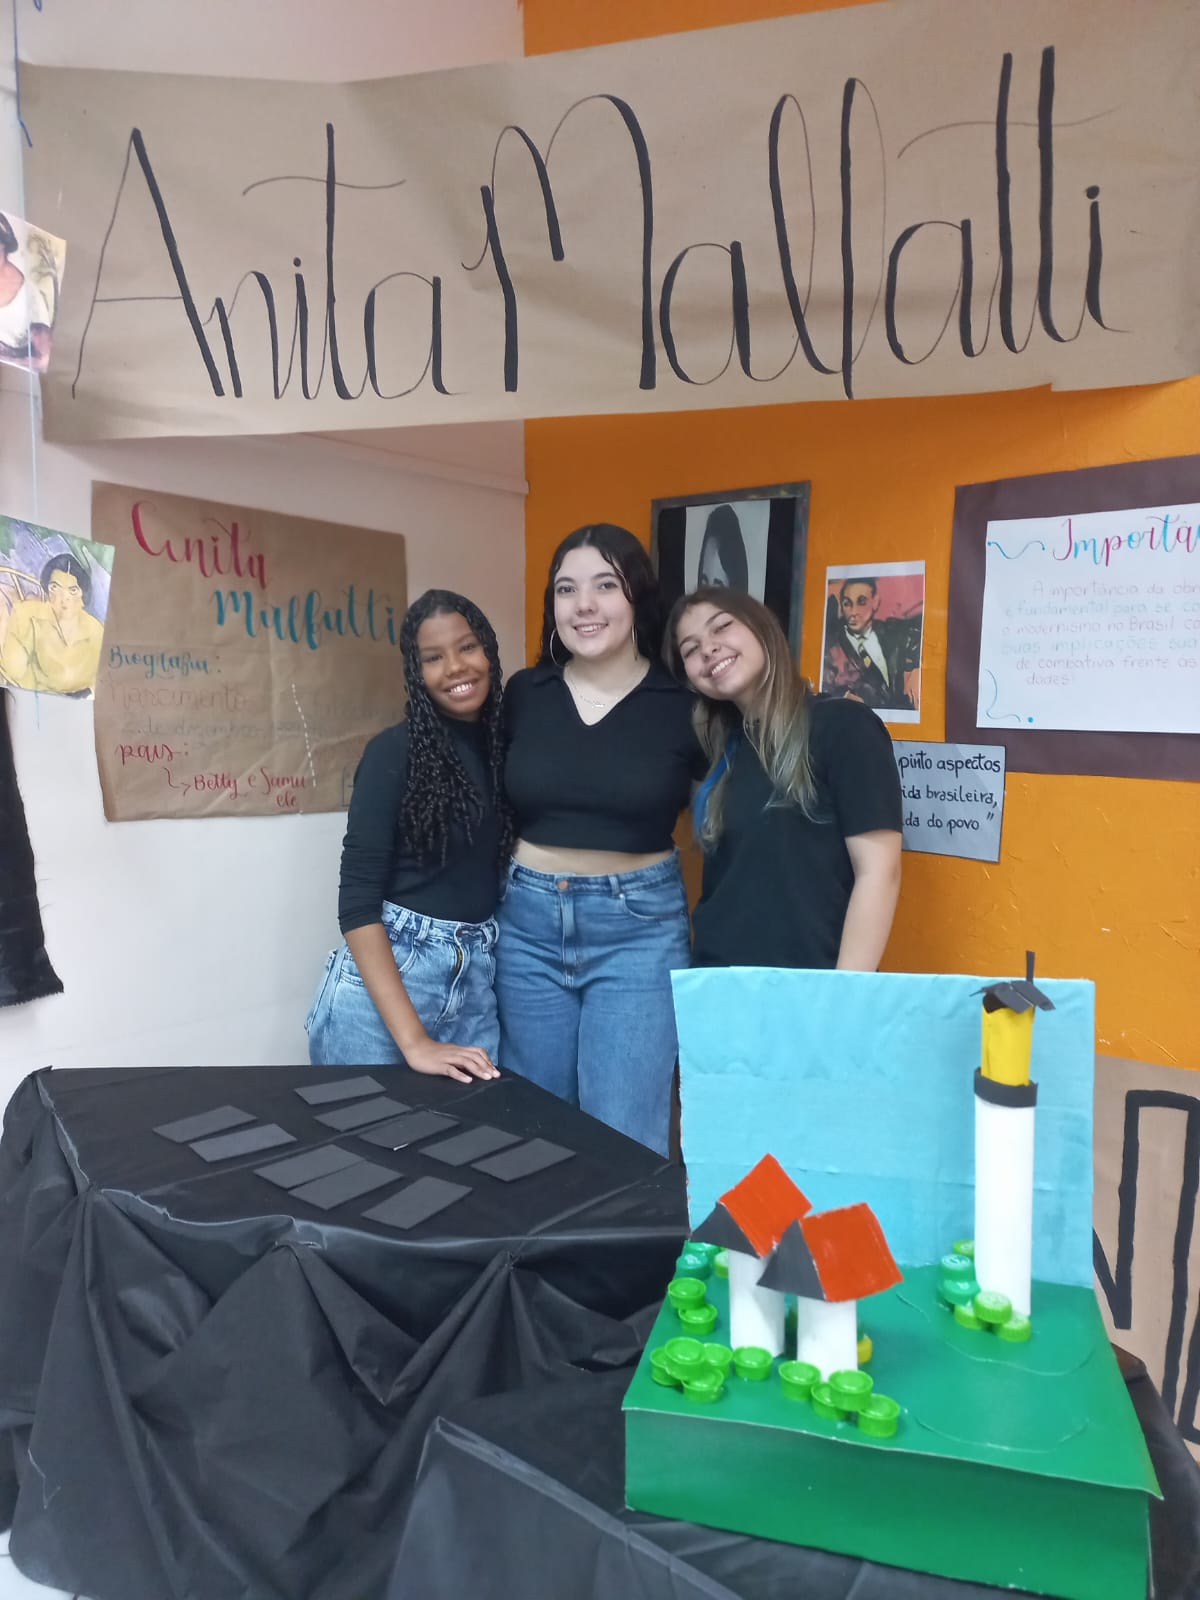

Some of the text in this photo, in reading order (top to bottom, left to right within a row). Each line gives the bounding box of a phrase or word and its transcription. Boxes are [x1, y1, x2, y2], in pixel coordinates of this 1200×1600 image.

[72, 45, 1131, 400] Anita Malfatti
[131, 501, 269, 590] Anita
[1052, 513, 1200, 567] Importâ
[1128, 615, 1175, 632] Brasil
[898, 750, 1002, 779] pinto aspectos
[901, 784, 999, 809] ida brasileira,
[926, 812, 944, 829] do
